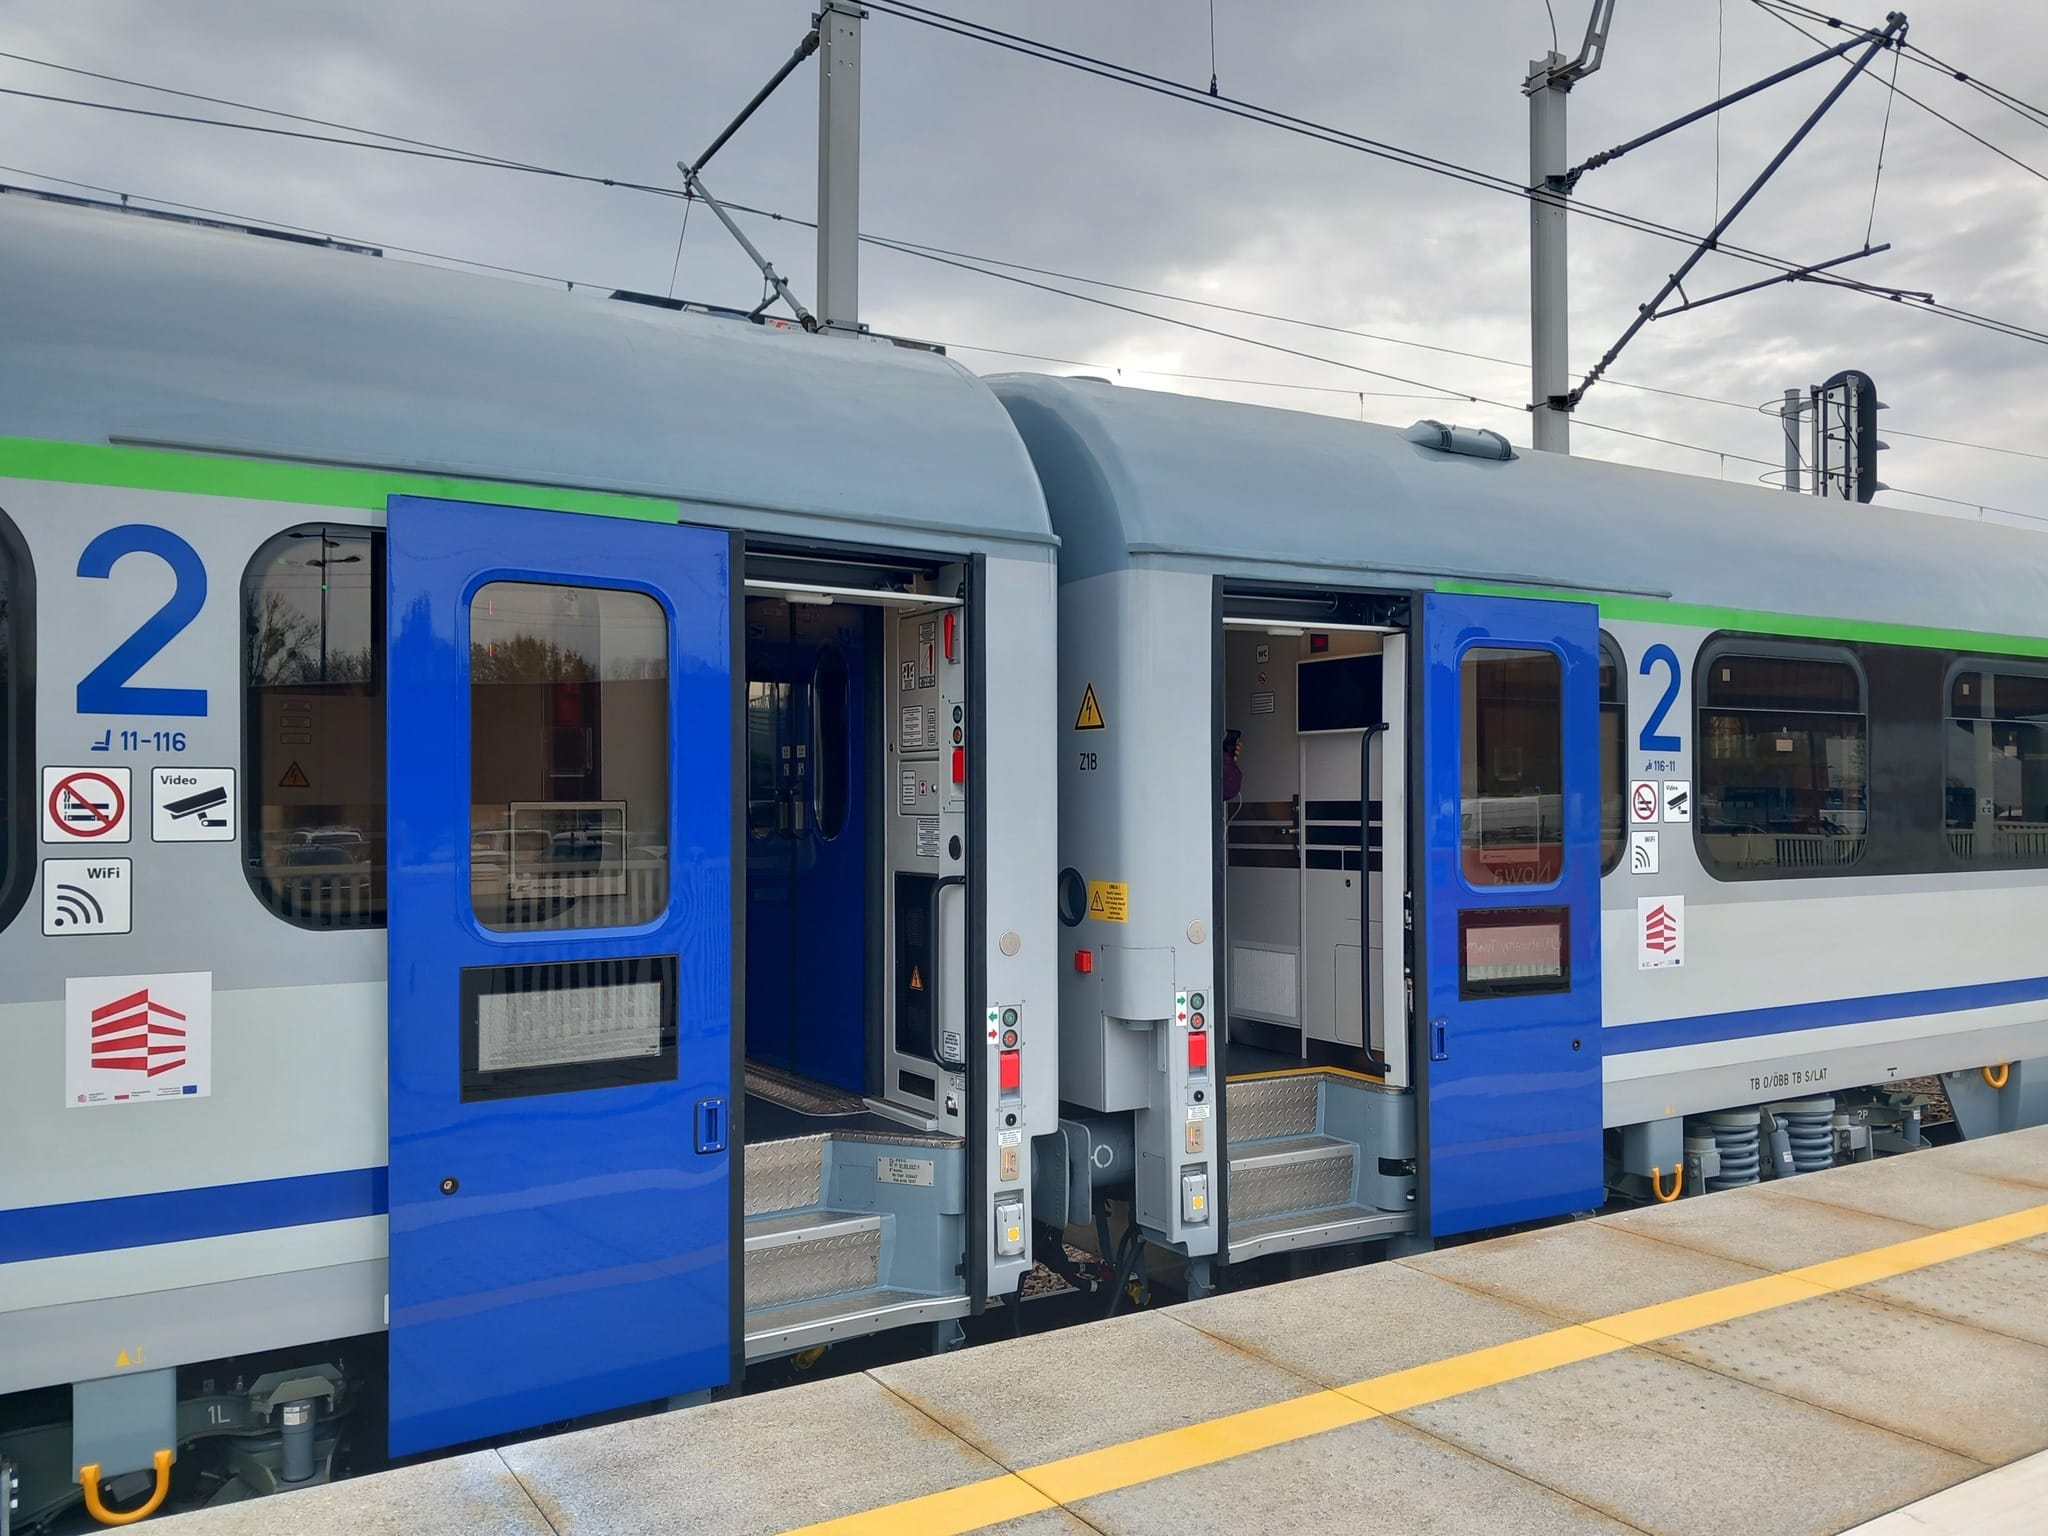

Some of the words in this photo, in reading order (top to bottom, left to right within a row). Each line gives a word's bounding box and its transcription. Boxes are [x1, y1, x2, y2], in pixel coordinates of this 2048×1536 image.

[77, 524, 208, 717] 2
[1640, 643, 1682, 752] 2
[120, 731, 186, 752] 11-116
[1079, 752, 1097, 771] Z1B
[1654, 760, 1676, 772] 116-11
[160, 775, 197, 787] Video
[87, 867, 120, 879] WiFi
[1750, 1077, 1760, 1091] TB
[1792, 1071, 1802, 1084] TB
[1805, 1068, 1827, 1082] S/LAT
[1857, 1109, 1869, 1121] 2P
[208, 1405, 230, 1424] 1L
